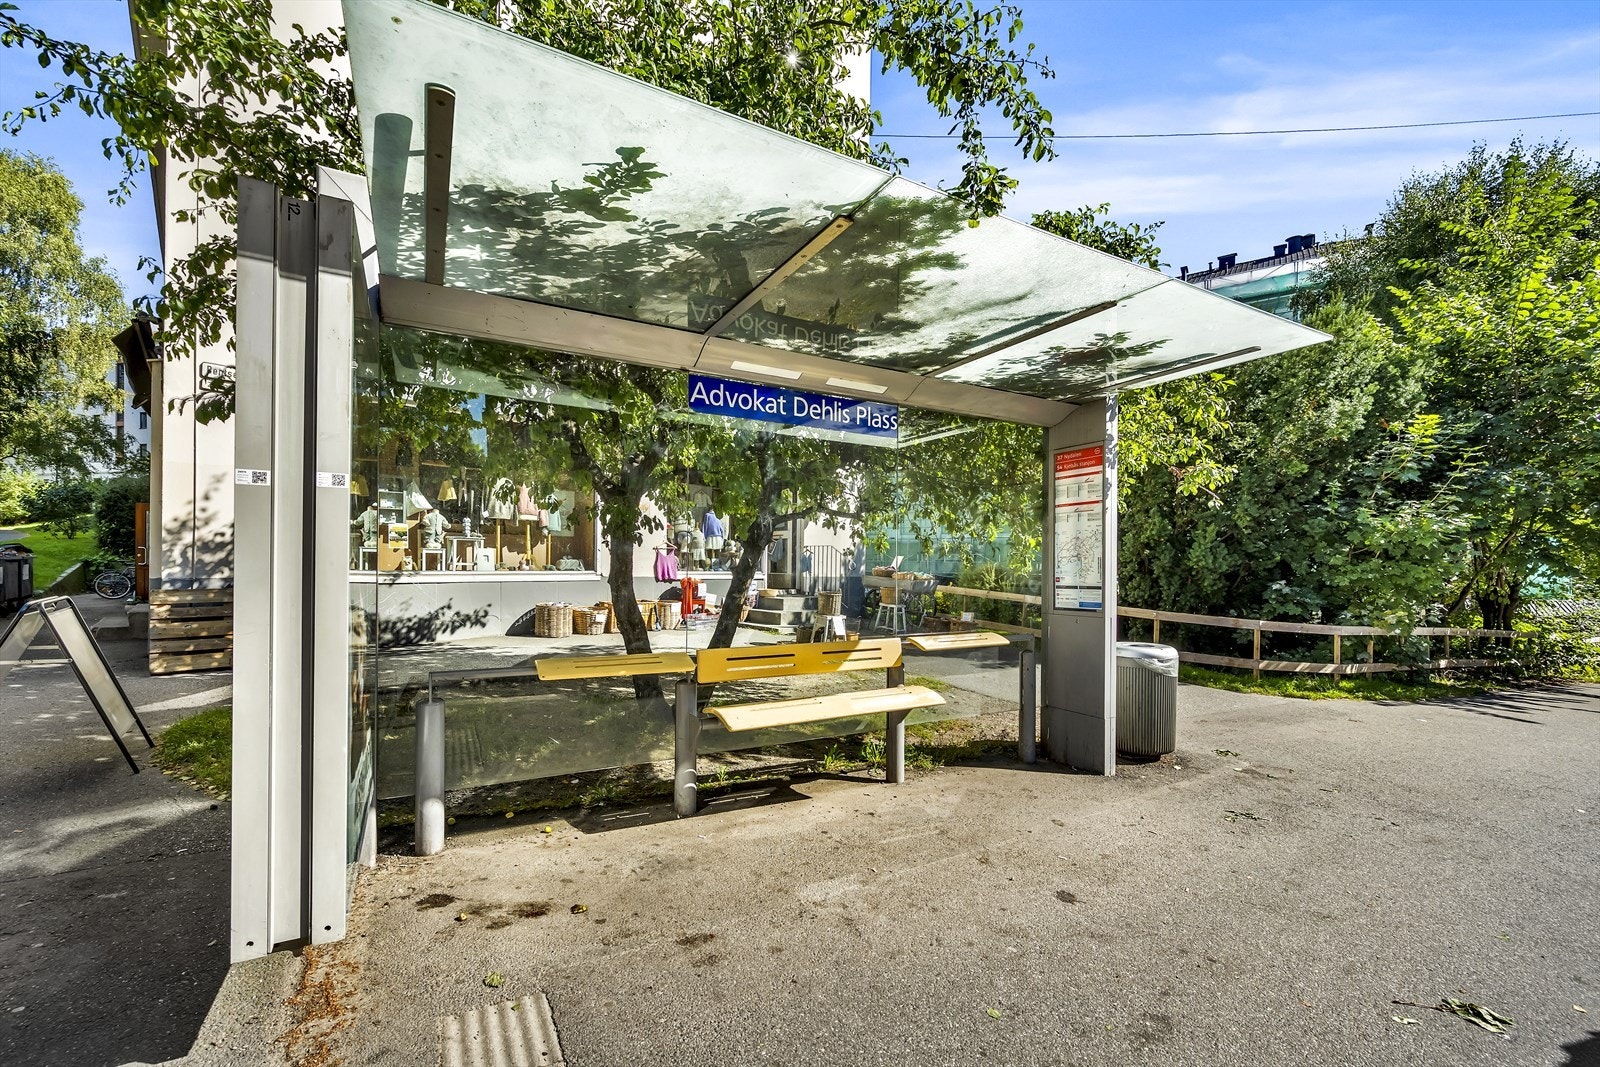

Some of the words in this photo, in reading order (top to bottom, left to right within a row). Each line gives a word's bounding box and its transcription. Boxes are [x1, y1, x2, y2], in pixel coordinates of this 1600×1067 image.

[690, 381, 787, 416] Advokat
[793, 395, 851, 424] Dehlis
[856, 405, 899, 431] Plass
